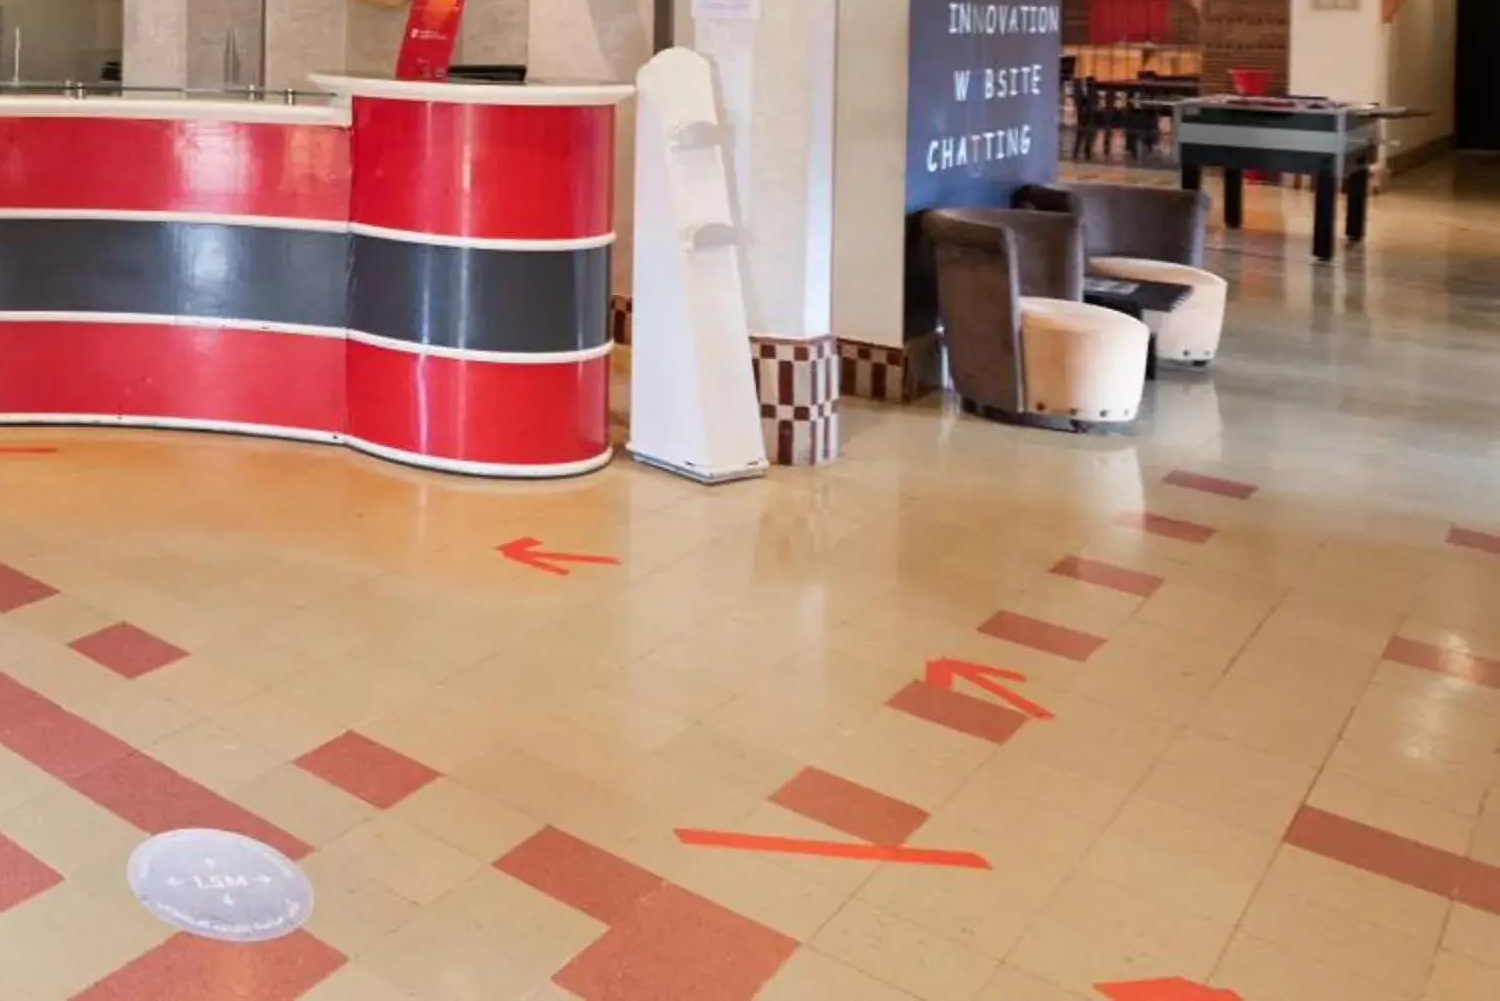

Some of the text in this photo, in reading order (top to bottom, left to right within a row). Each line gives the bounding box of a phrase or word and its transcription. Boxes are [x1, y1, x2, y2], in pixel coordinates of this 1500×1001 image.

[948, 1, 1060, 35] INNOVATION
[954, 64, 1042, 102] WBSITE
[926, 124, 1032, 173] CHATTING
